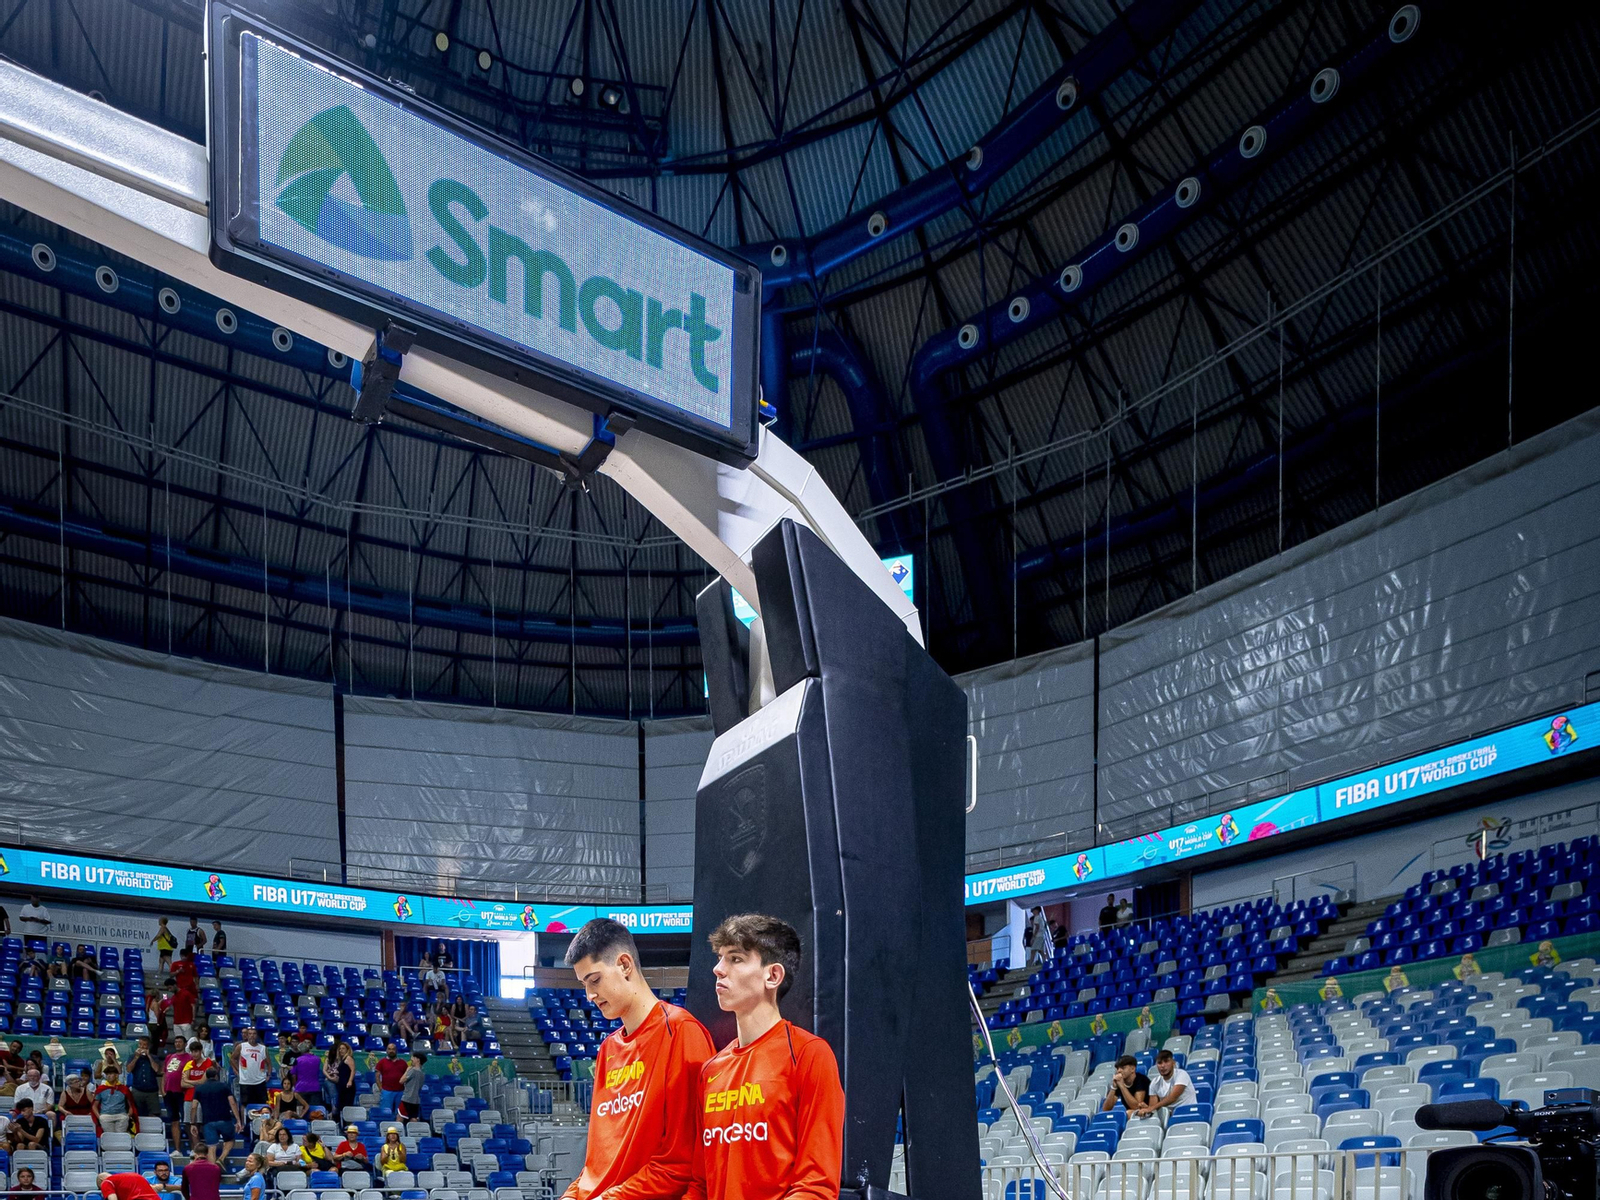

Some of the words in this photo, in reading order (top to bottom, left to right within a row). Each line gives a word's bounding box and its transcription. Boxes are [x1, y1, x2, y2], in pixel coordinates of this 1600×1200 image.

[424, 178, 720, 393] Smart
[1420, 757, 1445, 773] MEN'S
[1446, 744, 1497, 765] BASKETBALL
[1420, 763, 1466, 785] WORLD
[1470, 752, 1497, 771] CUP
[1335, 778, 1379, 808] FIBA
[1385, 766, 1420, 795] U17
[1169, 837, 1184, 849] U17
[41, 861, 80, 882] FIBA
[85, 867, 114, 885] U17
[115, 869, 135, 878] MEN'S
[135, 872, 172, 882] BASKETBALL
[116, 876, 150, 889] WORLD
[153, 880, 173, 891] CUP
[972, 878, 997, 897] U17
[997, 878, 1026, 893] WORLD
[1028, 874, 1045, 886] CUP
[253, 885, 287, 903] FIBA
[291, 889, 317, 906] U17
[317, 897, 348, 909] WORLD
[350, 901, 367, 911] CUP
[481, 911, 494, 920] U17
[641, 913, 662, 927] U17
[663, 917, 690, 927] WORLD
[73, 923, 107, 937] MARTÍN
[110, 927, 150, 940] CARPENA
[251, 1053, 258, 1061] 4
[705, 1082, 765, 1113] ESPÑA
